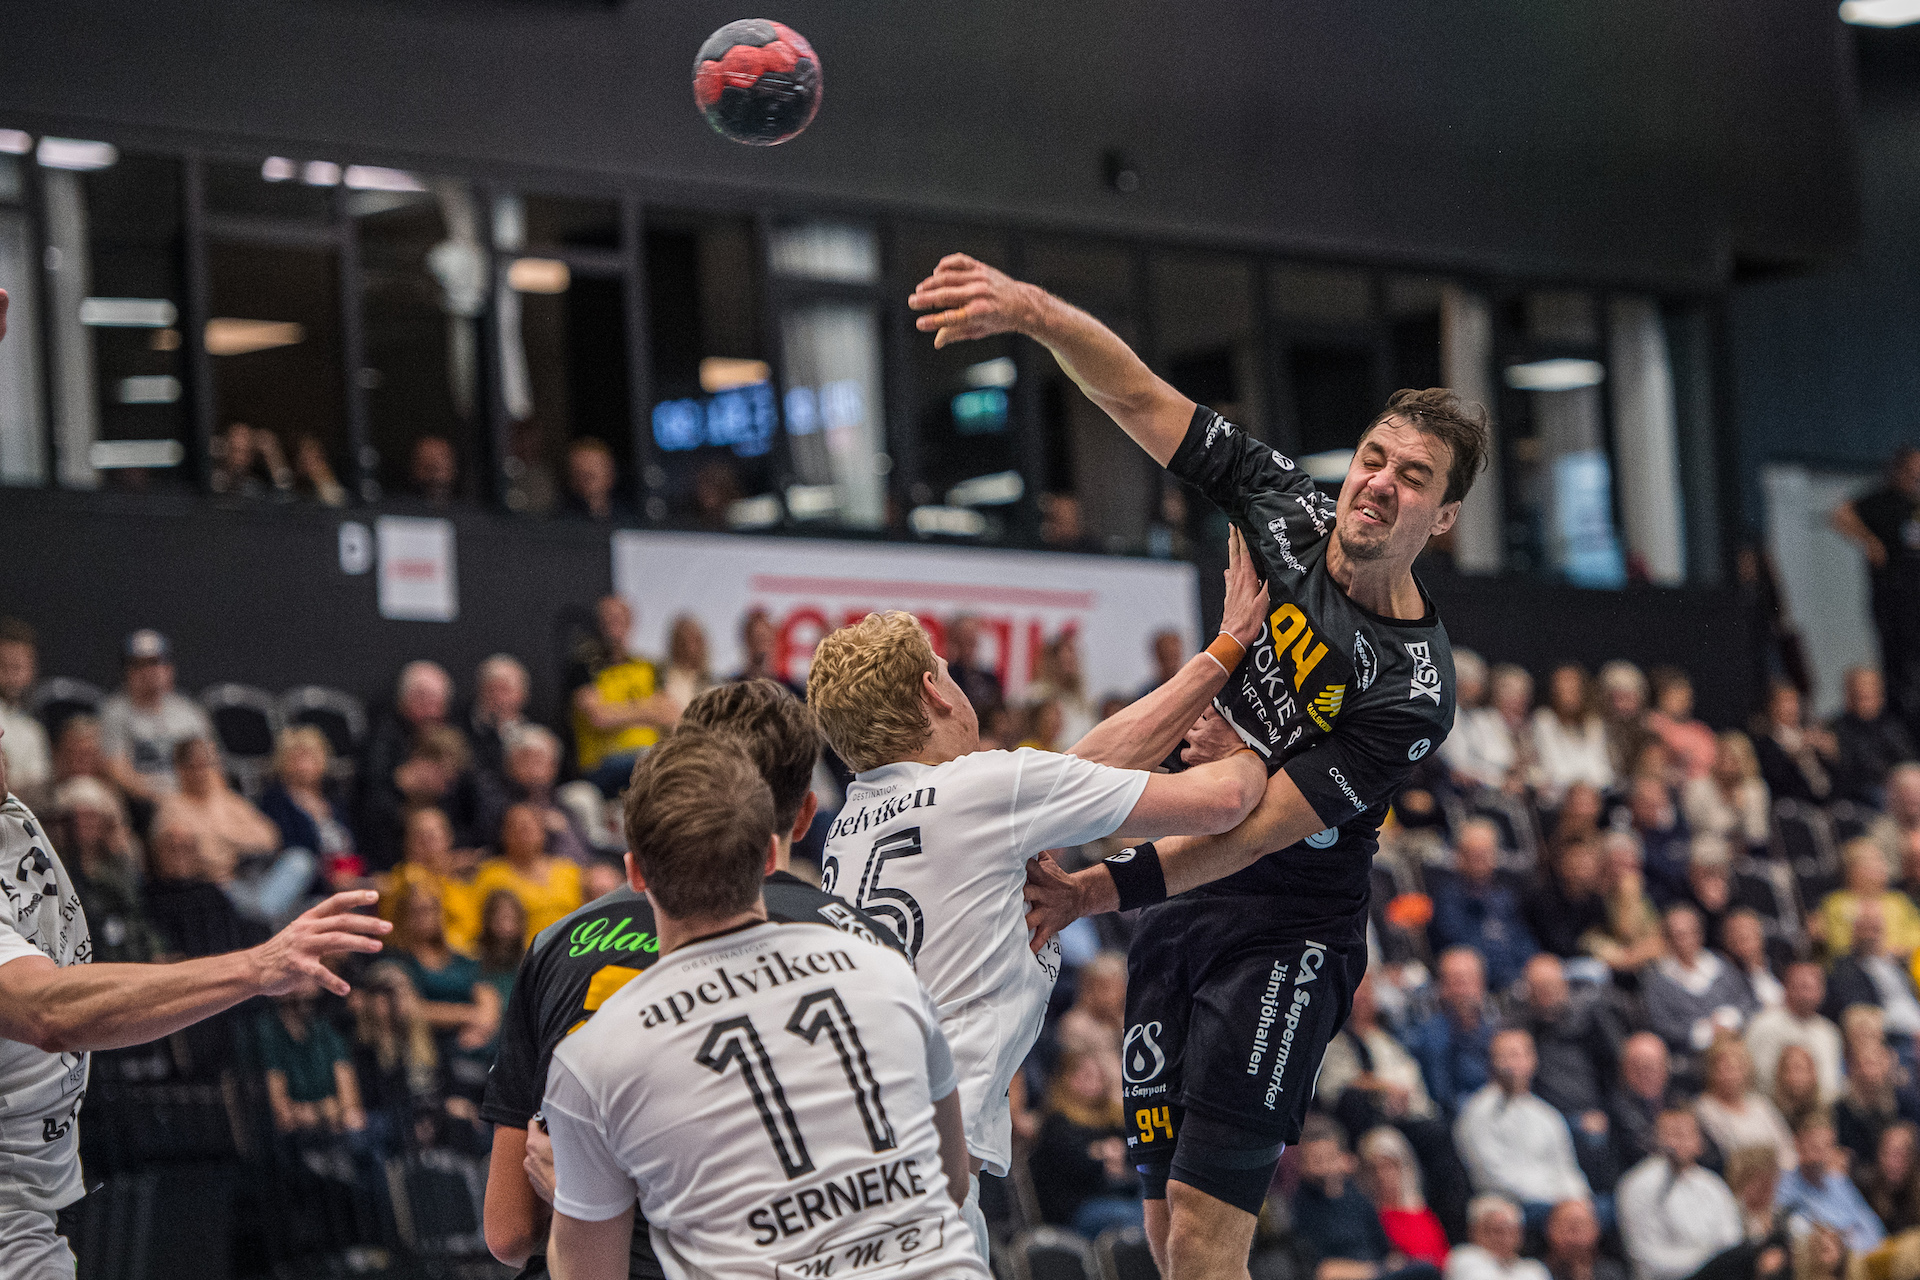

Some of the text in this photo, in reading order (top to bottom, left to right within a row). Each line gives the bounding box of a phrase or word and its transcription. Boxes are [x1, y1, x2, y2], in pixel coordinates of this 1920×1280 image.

[1404, 641, 1442, 707] EKSX
[826, 787, 937, 847] pelviken
[852, 784, 899, 802] DESTINATION
[637, 949, 858, 1029] apelviken
[1247, 960, 1289, 1076] Jämjöhallen
[1264, 939, 1328, 1111] ICA Supermarket
[694, 987, 897, 1180] 11
[1131, 1083, 1167, 1098] Support
[1135, 1106, 1174, 1144] 94
[746, 1160, 927, 1247] SERNEKE
